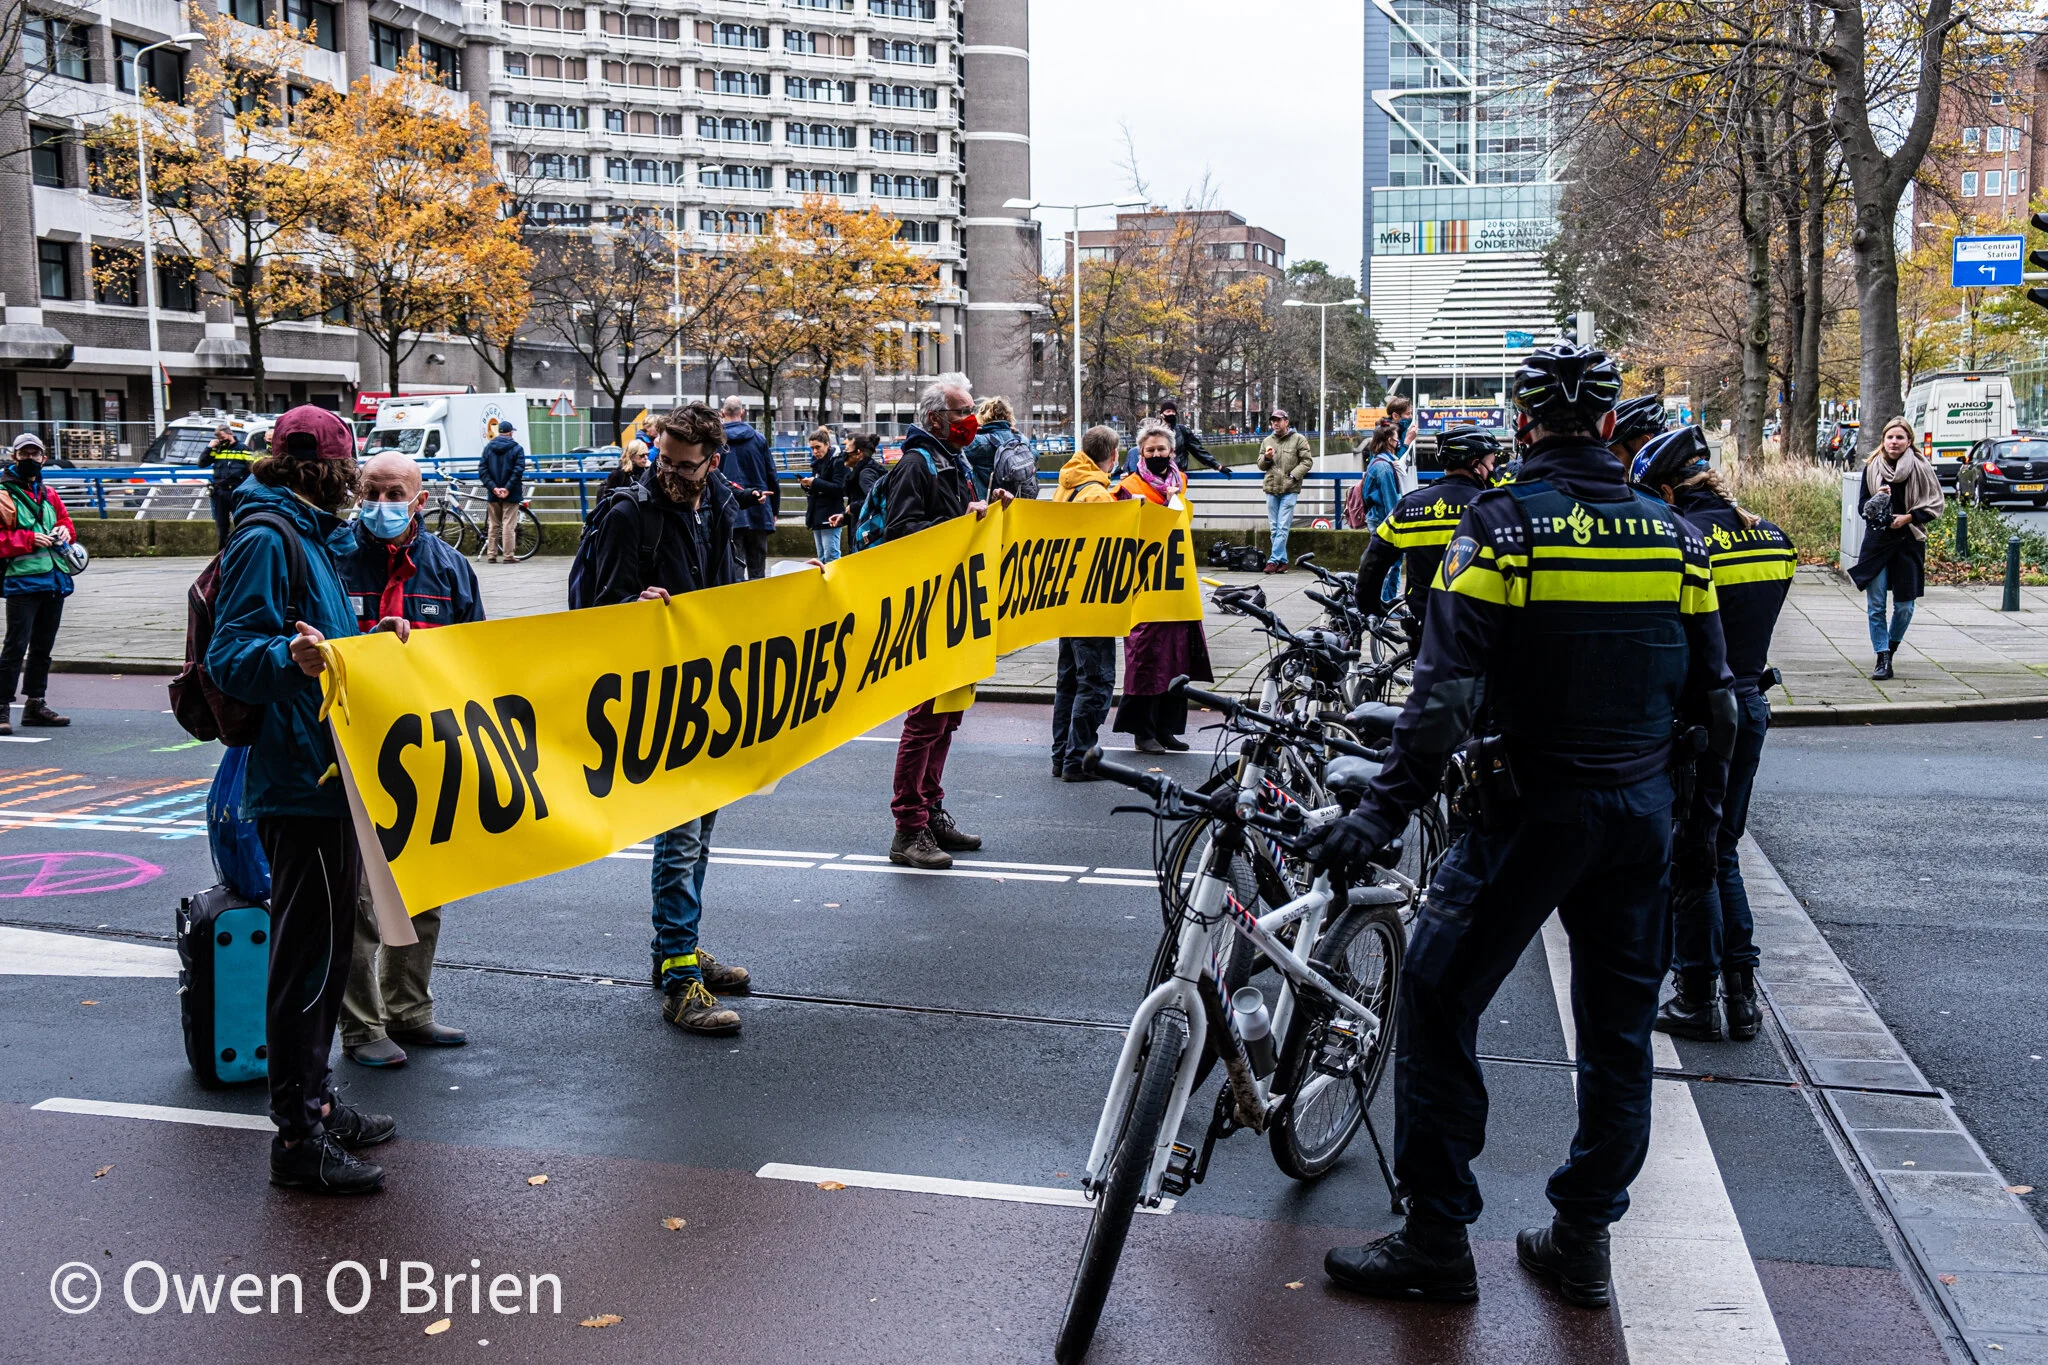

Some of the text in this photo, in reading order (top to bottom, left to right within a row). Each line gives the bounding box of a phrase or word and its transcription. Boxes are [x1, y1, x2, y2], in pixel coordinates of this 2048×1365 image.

[1380, 232, 1411, 244] MKB
[1481, 229, 1505, 238] DAG
[1508, 228, 1532, 238] VAN
[1982, 242, 2018, 250] Centraal
[482, 407, 504, 424] BAGEL
[1433, 411, 1489, 419] ASTA CASINO
[1552, 513, 1666, 545] POLITIE
[1704, 526, 1772, 549] POLITIE
[375, 694, 549, 863] STOP
[582, 612, 855, 798] SUBSIDIES
[856, 574, 942, 693] AAN
[946, 553, 991, 649] DE
[998, 537, 1086, 621] OSSIELE
[1282, 903, 1310, 923] SANTOS
